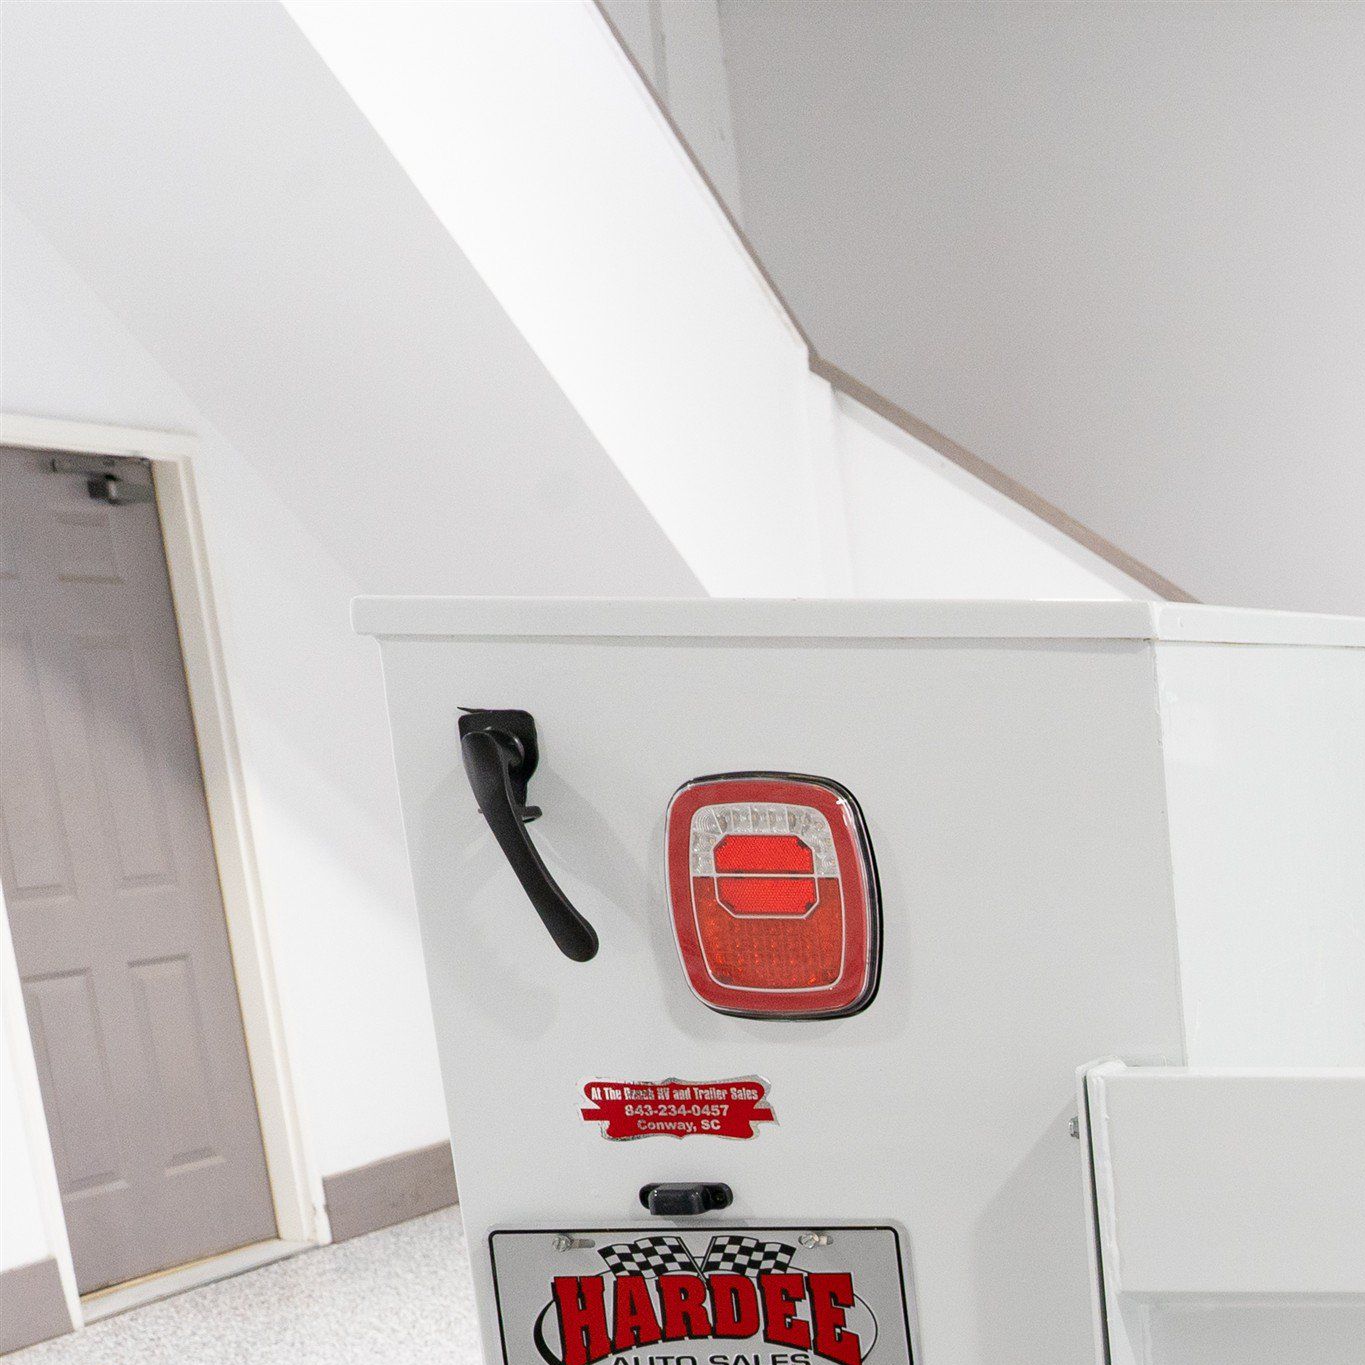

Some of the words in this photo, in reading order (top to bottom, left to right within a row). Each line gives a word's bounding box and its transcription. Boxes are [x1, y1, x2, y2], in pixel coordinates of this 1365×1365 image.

[591, 1087, 602, 1100] At
[603, 1087, 622, 1100] The
[673, 1087, 691, 1100] and
[693, 1087, 727, 1100] Trailer
[730, 1087, 758, 1100] Sales
[624, 1104, 729, 1117] 843-234-0457
[637, 1119, 697, 1132] Conway,
[701, 1119, 721, 1130] SC
